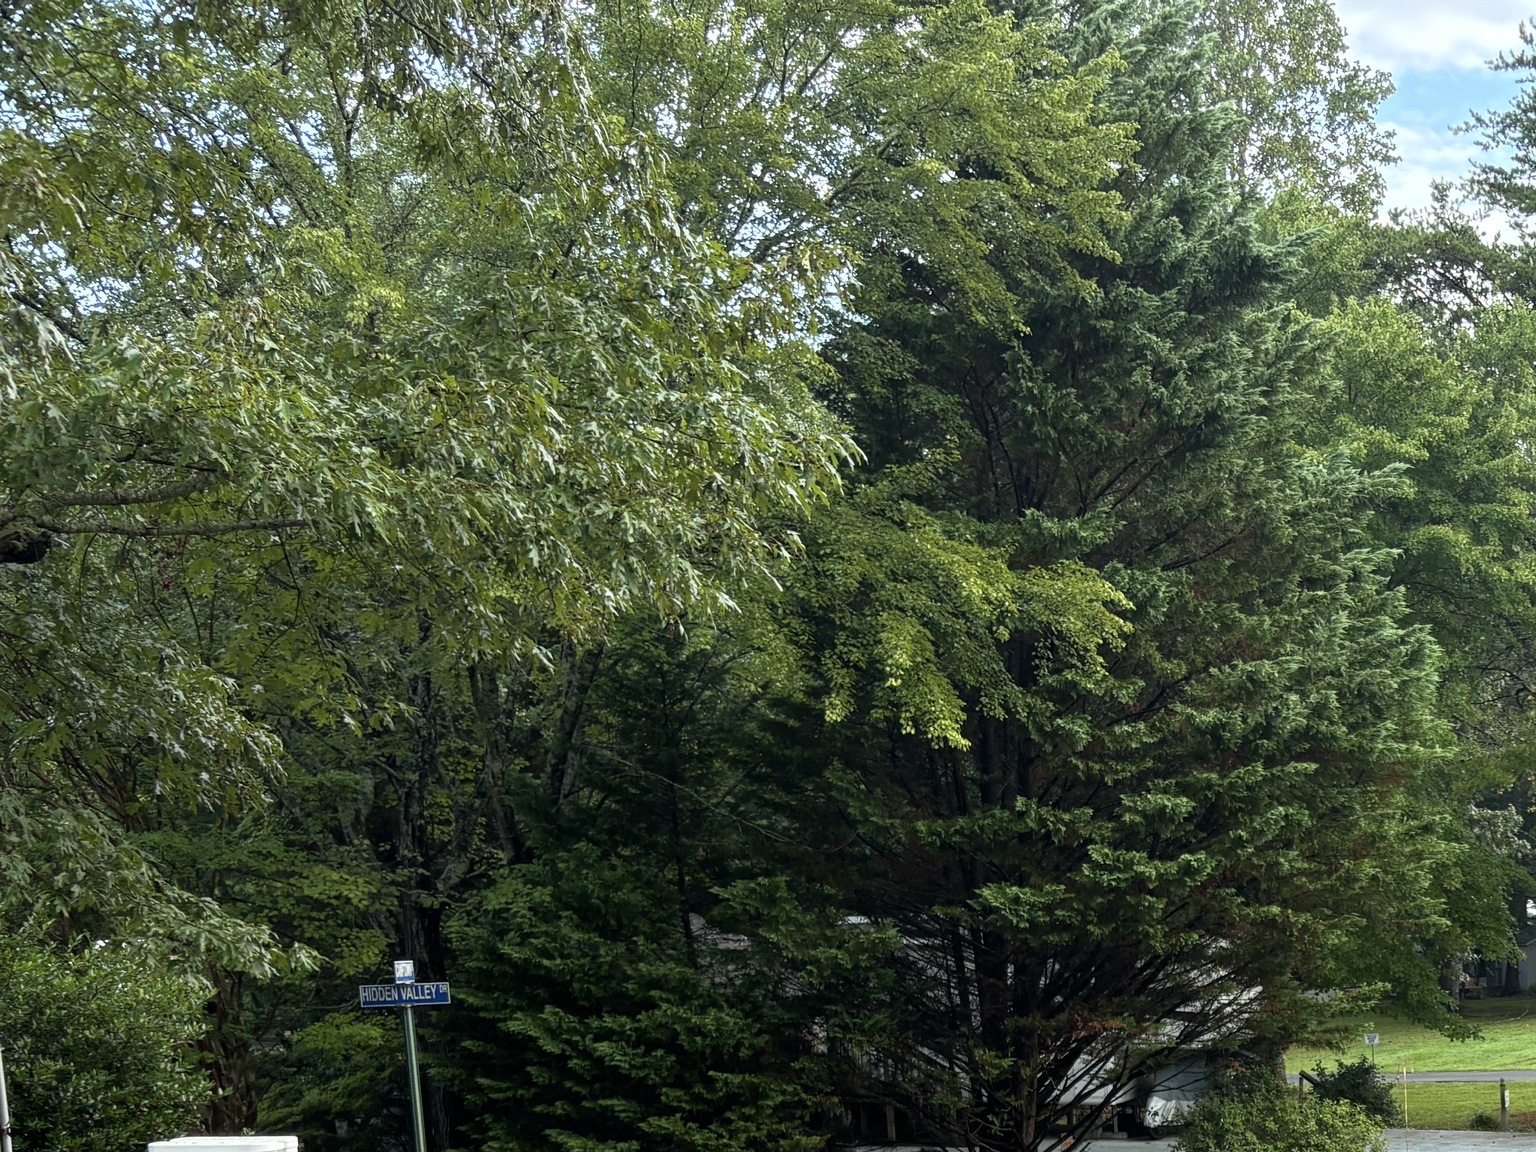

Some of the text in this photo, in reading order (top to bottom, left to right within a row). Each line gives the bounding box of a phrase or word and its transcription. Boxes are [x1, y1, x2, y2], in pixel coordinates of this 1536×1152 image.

[362, 985, 448, 1002] HIDDEN VALLEY DR
